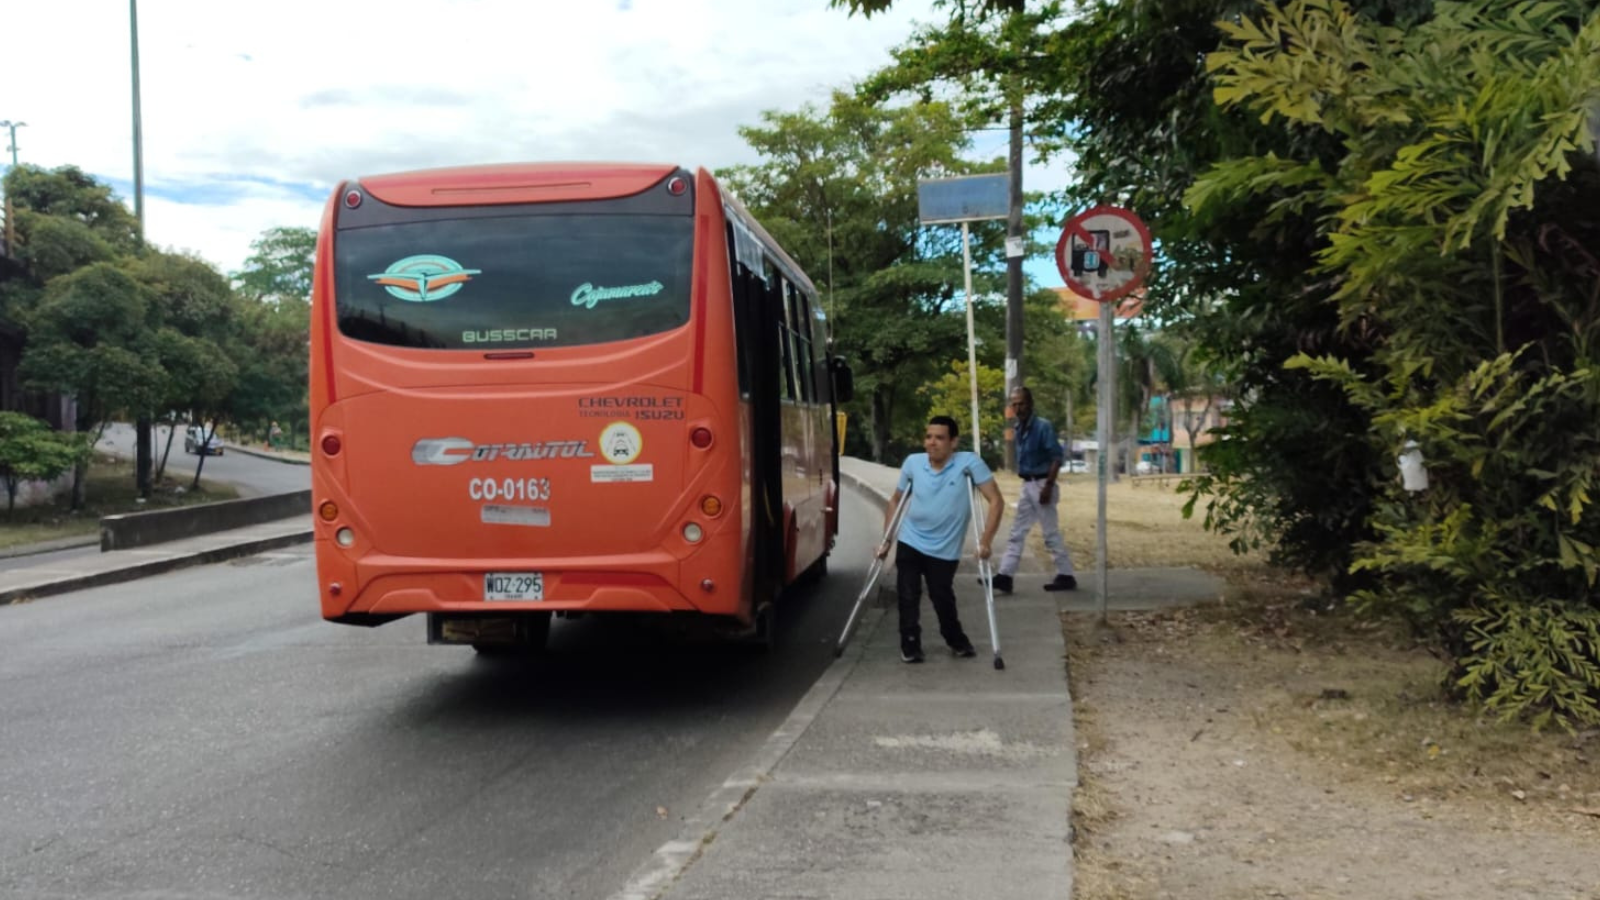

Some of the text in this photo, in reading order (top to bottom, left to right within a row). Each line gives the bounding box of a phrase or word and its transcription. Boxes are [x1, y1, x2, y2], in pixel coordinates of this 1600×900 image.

[462, 326, 558, 343] BUSSCAR
[578, 396, 684, 408] CHEVROLET
[635, 410, 685, 420] ISUZU
[469, 477, 550, 501] CO-0163
